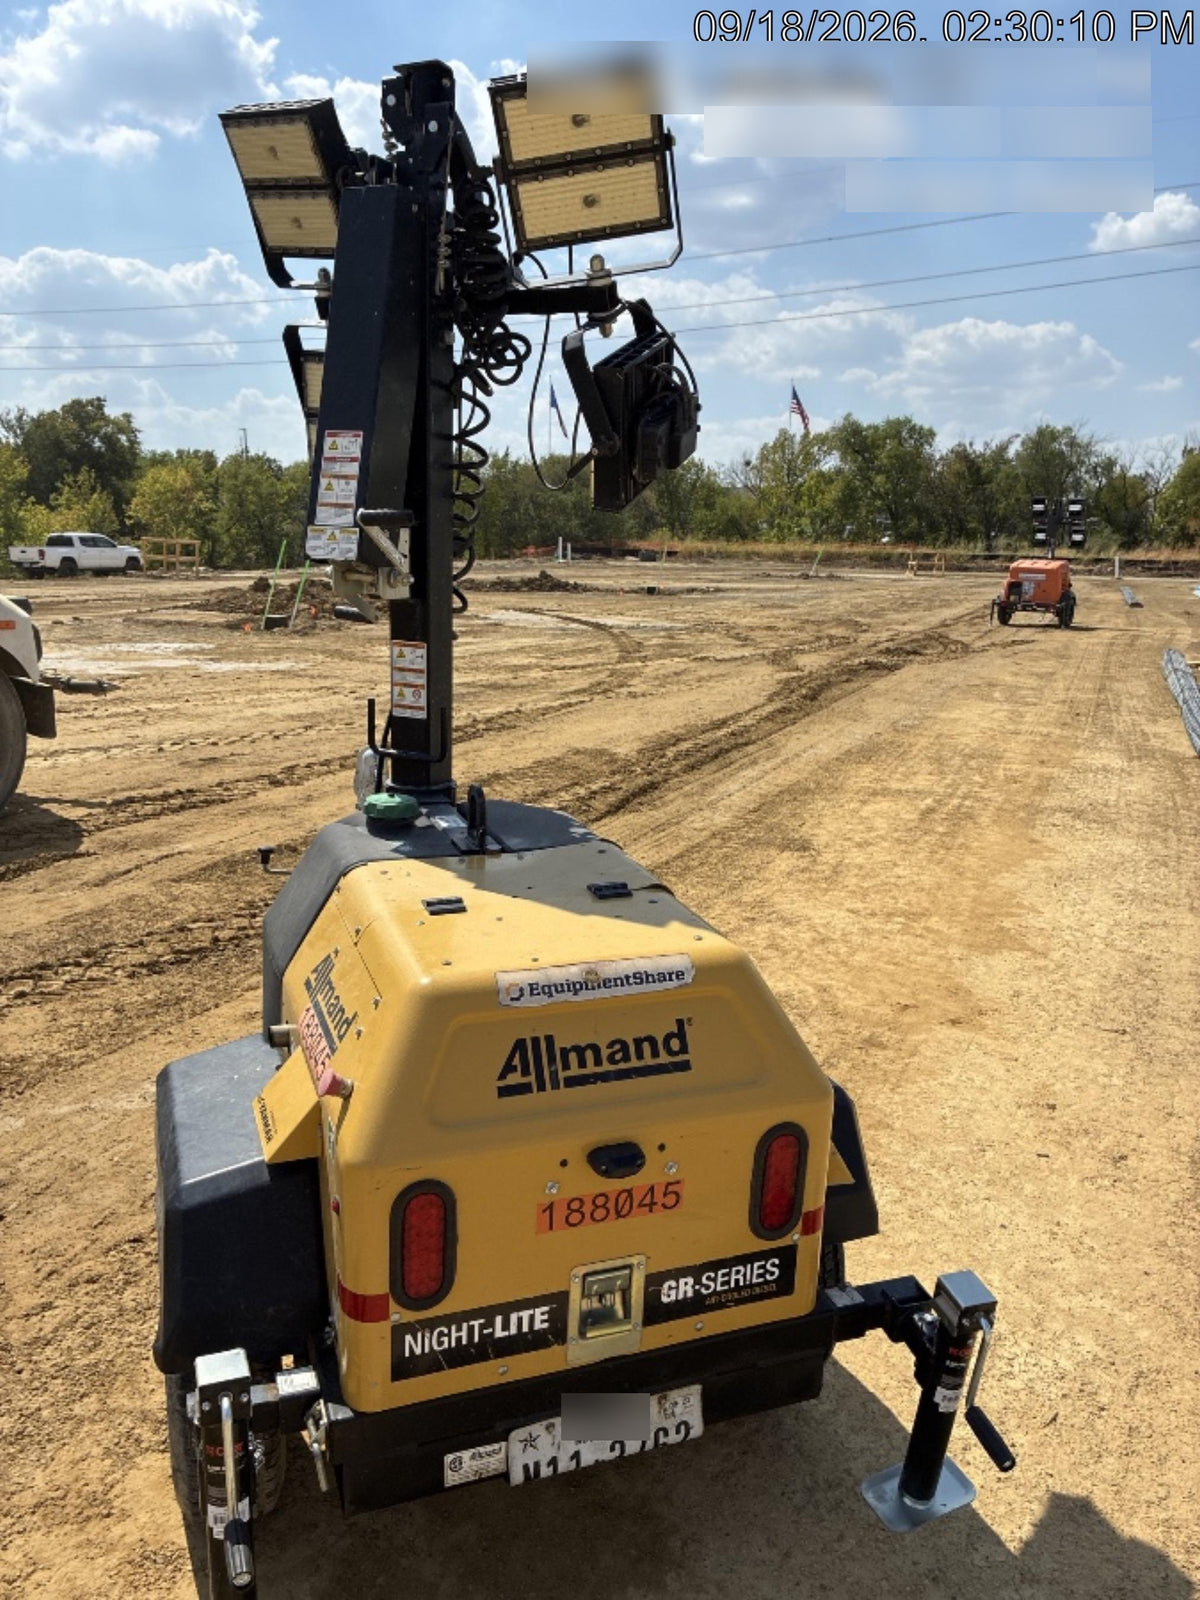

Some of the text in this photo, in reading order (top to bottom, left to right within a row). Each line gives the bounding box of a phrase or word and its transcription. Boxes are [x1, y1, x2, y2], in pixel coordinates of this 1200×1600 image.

[306, 953, 358, 1046] Allmand
[497, 1018, 691, 1093] Allmand
[541, 1180, 683, 1232] 188045
[660, 1258, 780, 1304] GR-SERIES
[404, 1305, 550, 1358] NIGHT-LITE
